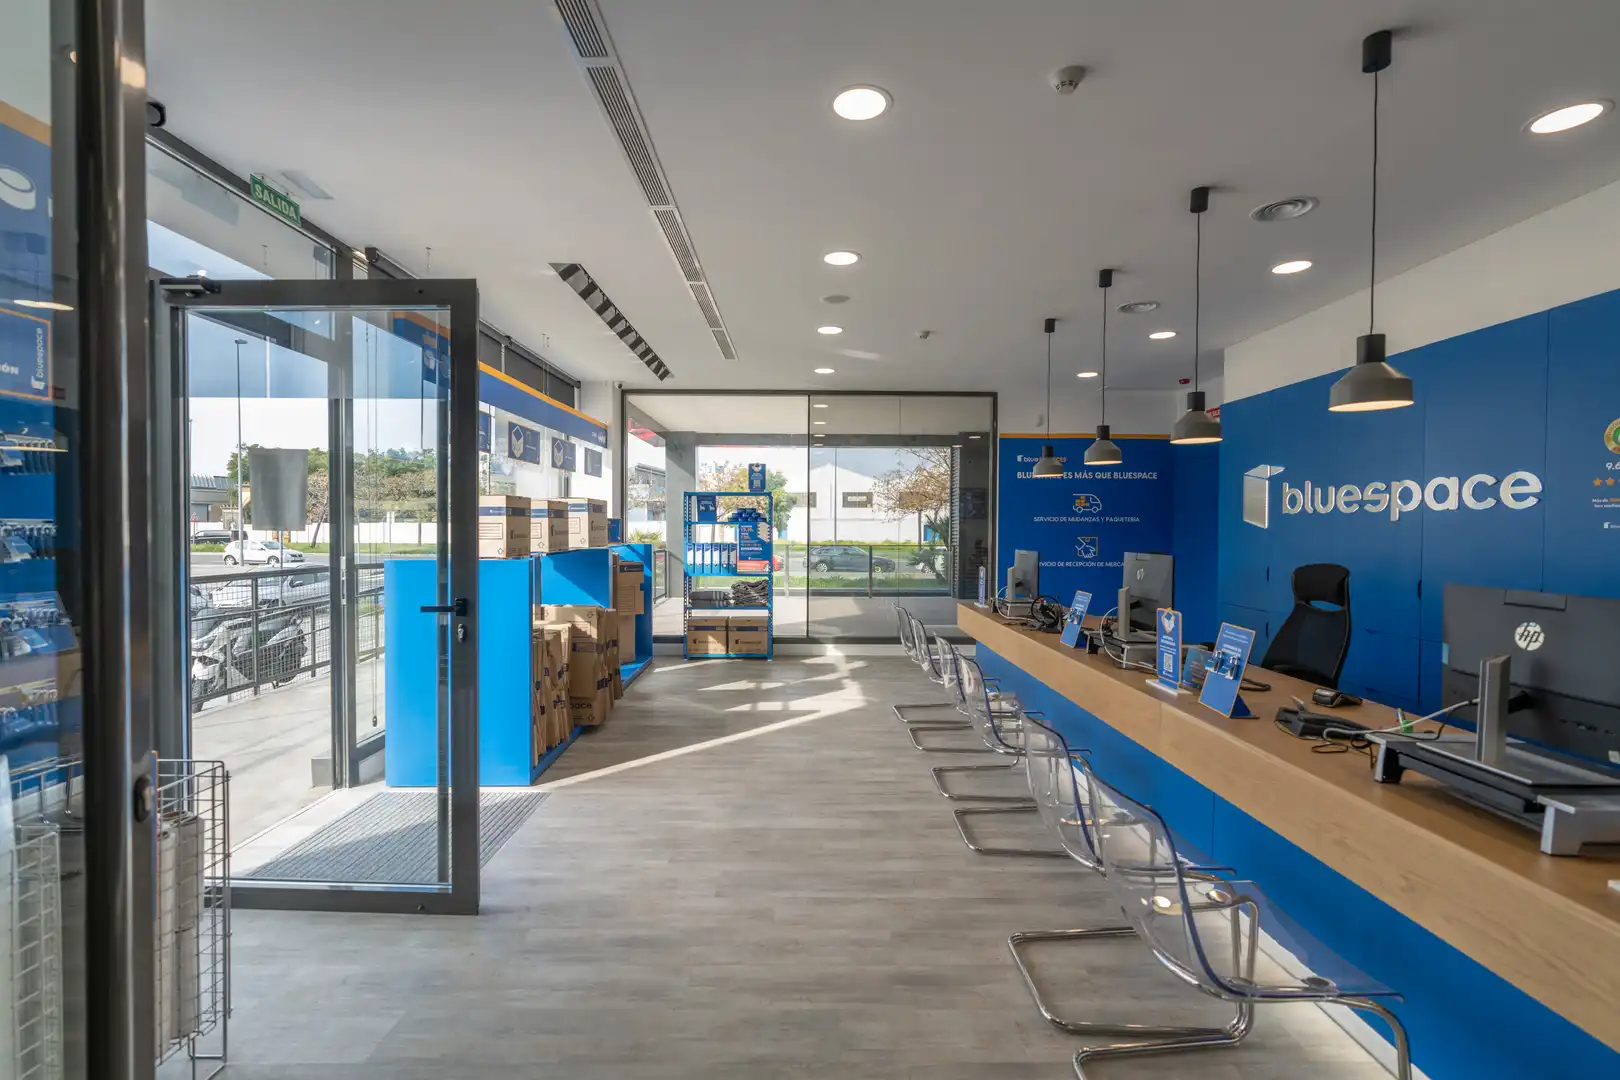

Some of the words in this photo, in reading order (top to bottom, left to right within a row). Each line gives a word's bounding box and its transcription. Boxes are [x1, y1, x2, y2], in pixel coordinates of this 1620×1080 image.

[254, 184, 297, 219] SALIDA
[1074, 470, 1093, 479] MÁS
[1095, 472, 1112, 480] QUE
[1113, 472, 1158, 480] BLUESPACE
[1281, 470, 1543, 522] bluespace
[1517, 622, 1543, 651] hp
